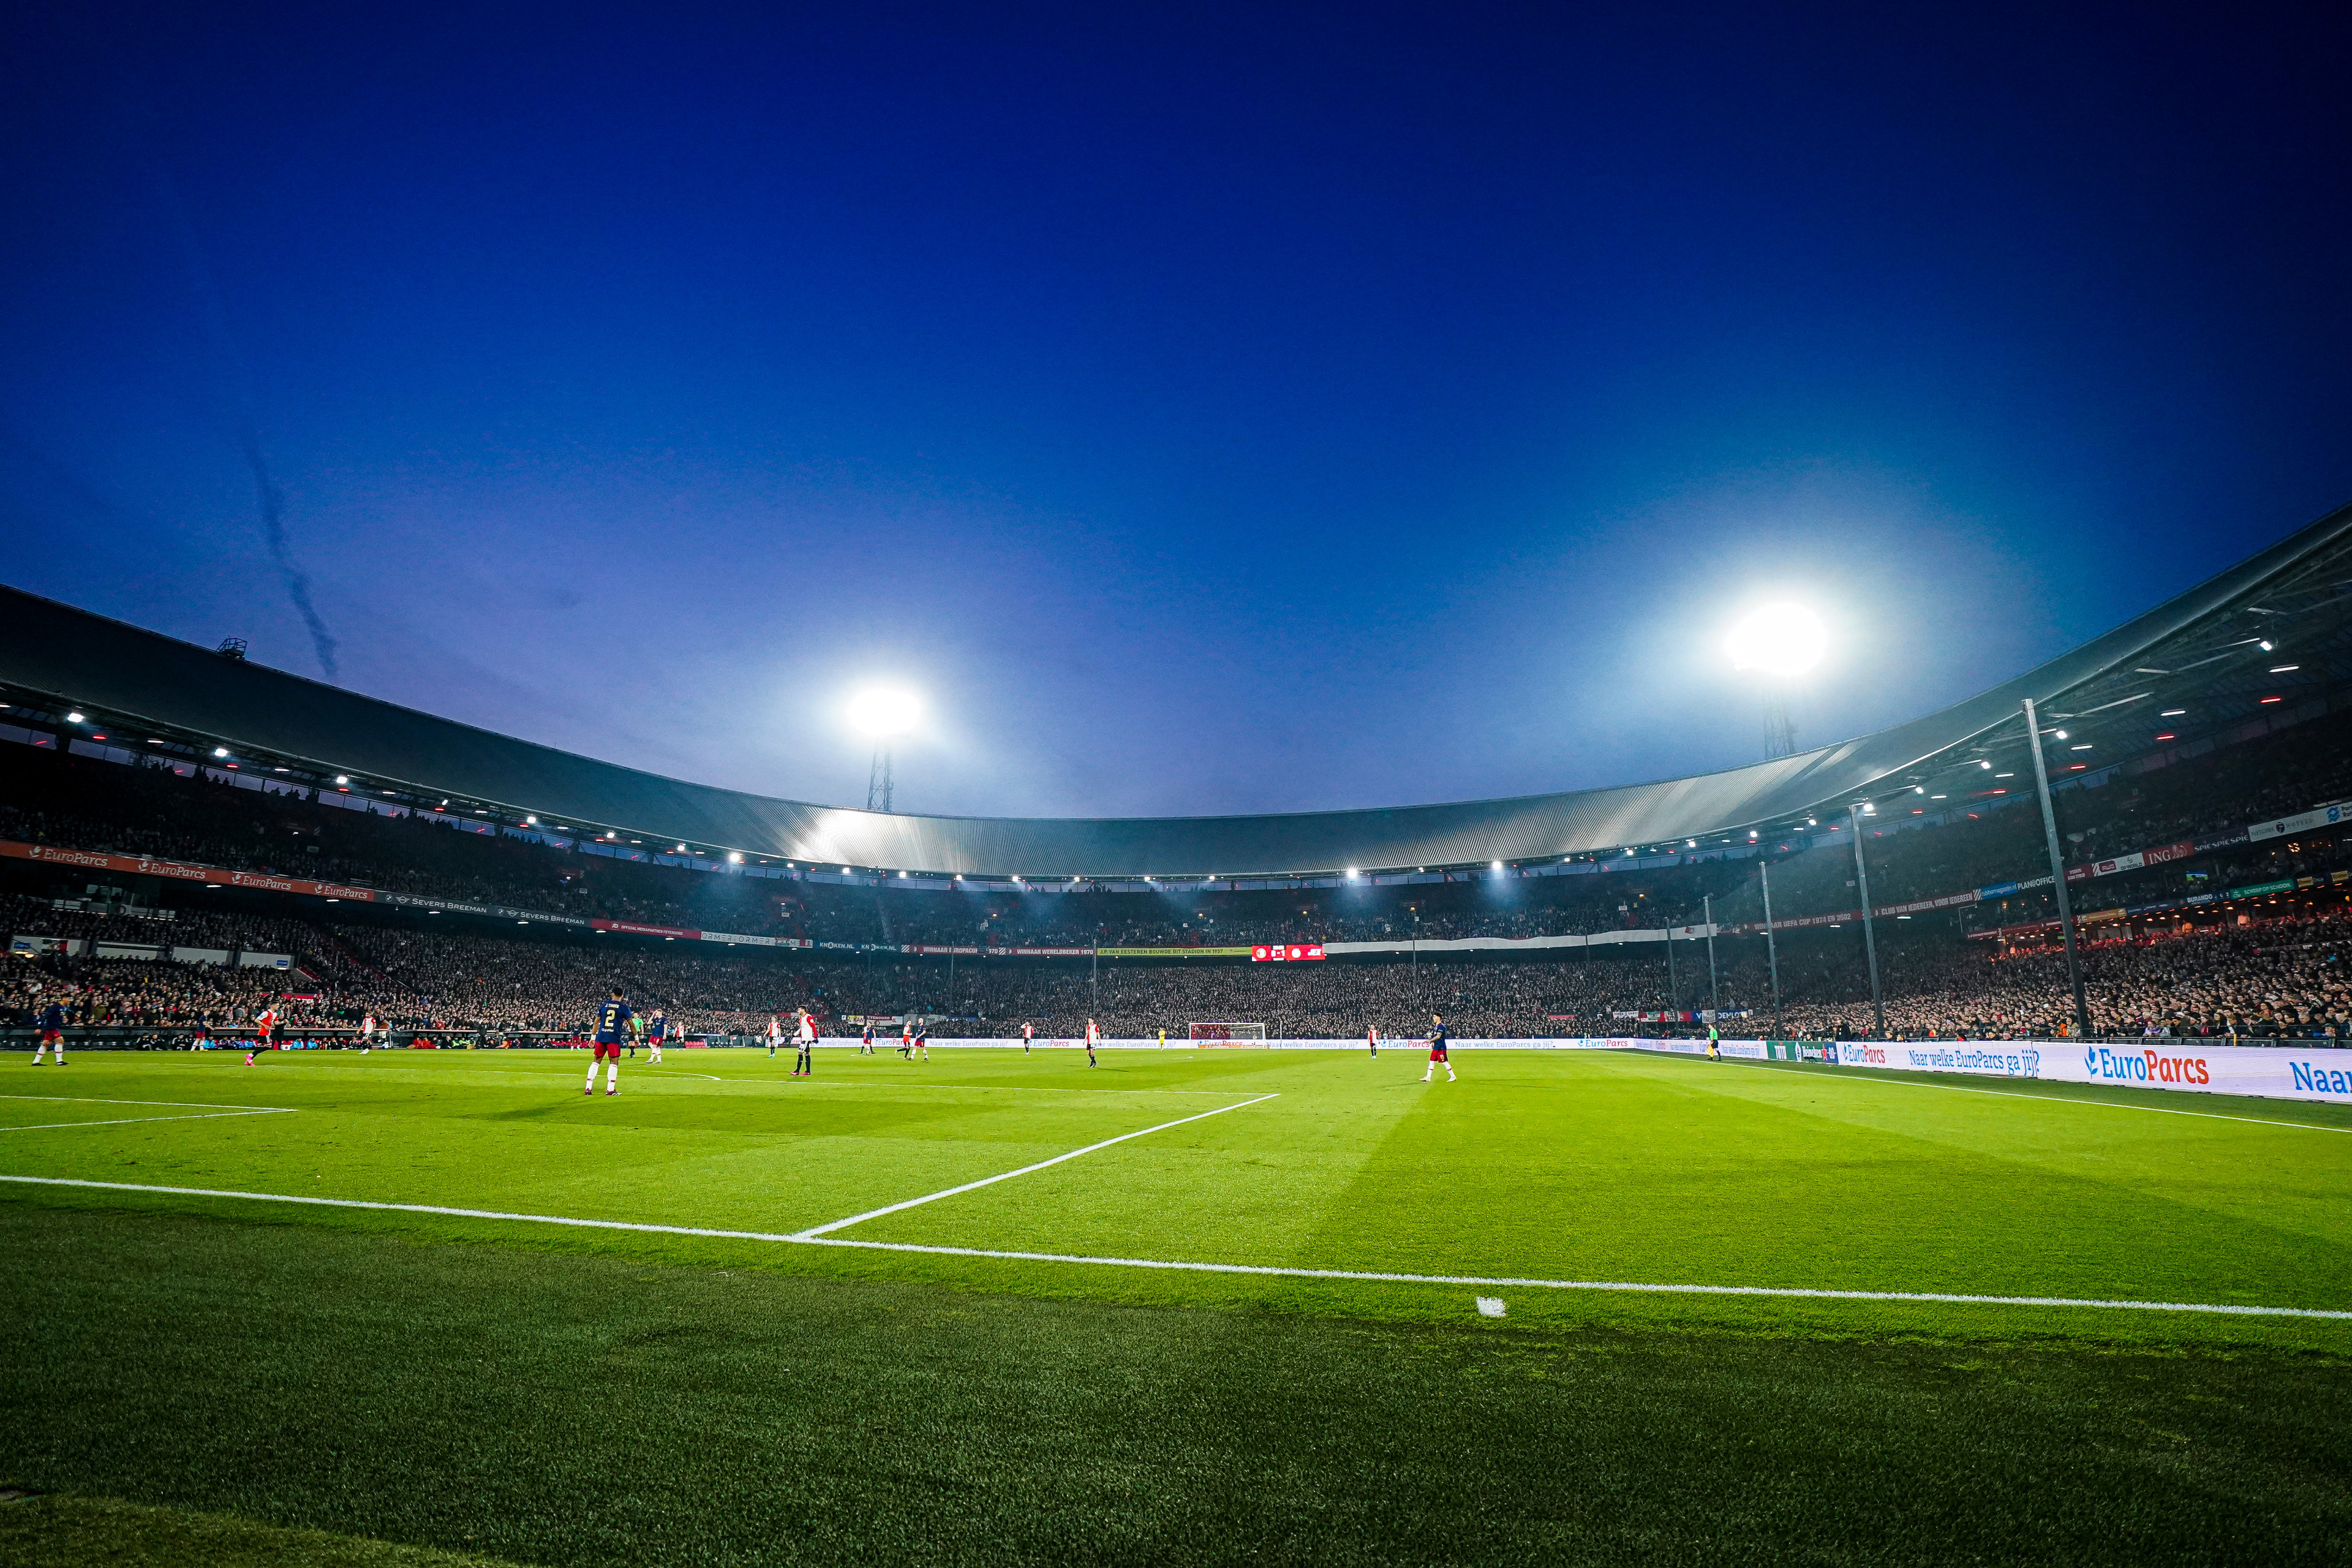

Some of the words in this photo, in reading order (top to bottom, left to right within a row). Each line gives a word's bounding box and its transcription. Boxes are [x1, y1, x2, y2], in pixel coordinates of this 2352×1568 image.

[2212, 839, 2230, 848] SPIE
[2230, 835, 2250, 843] SPIE
[43, 848, 108, 867] EuroParcs
[2148, 850, 2171, 864] ING
[150, 863, 206, 879] EuroParcs
[243, 875, 292, 890] EuroParcs
[2017, 876, 2056, 890] PLAN@OFFICE
[324, 886, 368, 899] EuroParcs
[2187, 894, 2213, 902] BURANDO
[412, 898, 445, 908] SEVERS
[447, 903, 487, 913] BREEMAN
[1935, 898, 1948, 907] VOOR
[1949, 893, 1973, 904] IEDEREEN
[520, 911, 549, 920] SEVERS
[551, 916, 584, 925] BREEMAN
[605, 1009, 616, 1027] 2
[1542, 1041, 1553, 1050] jij?
[1774, 1045, 1787, 1060] TOTO
[1802, 1046, 1822, 1058] Heineken
[1848, 1044, 1885, 1063] EuroParcs
[1909, 1050, 1928, 1066] Naar
[1929, 1049, 1954, 1067] welke
[1955, 1050, 2004, 1069] EuroParcs
[2007, 1055, 2020, 1075] ga
[2022, 1049, 2040, 1077] jij?
[2099, 1048, 2209, 1085] EuroParcs
